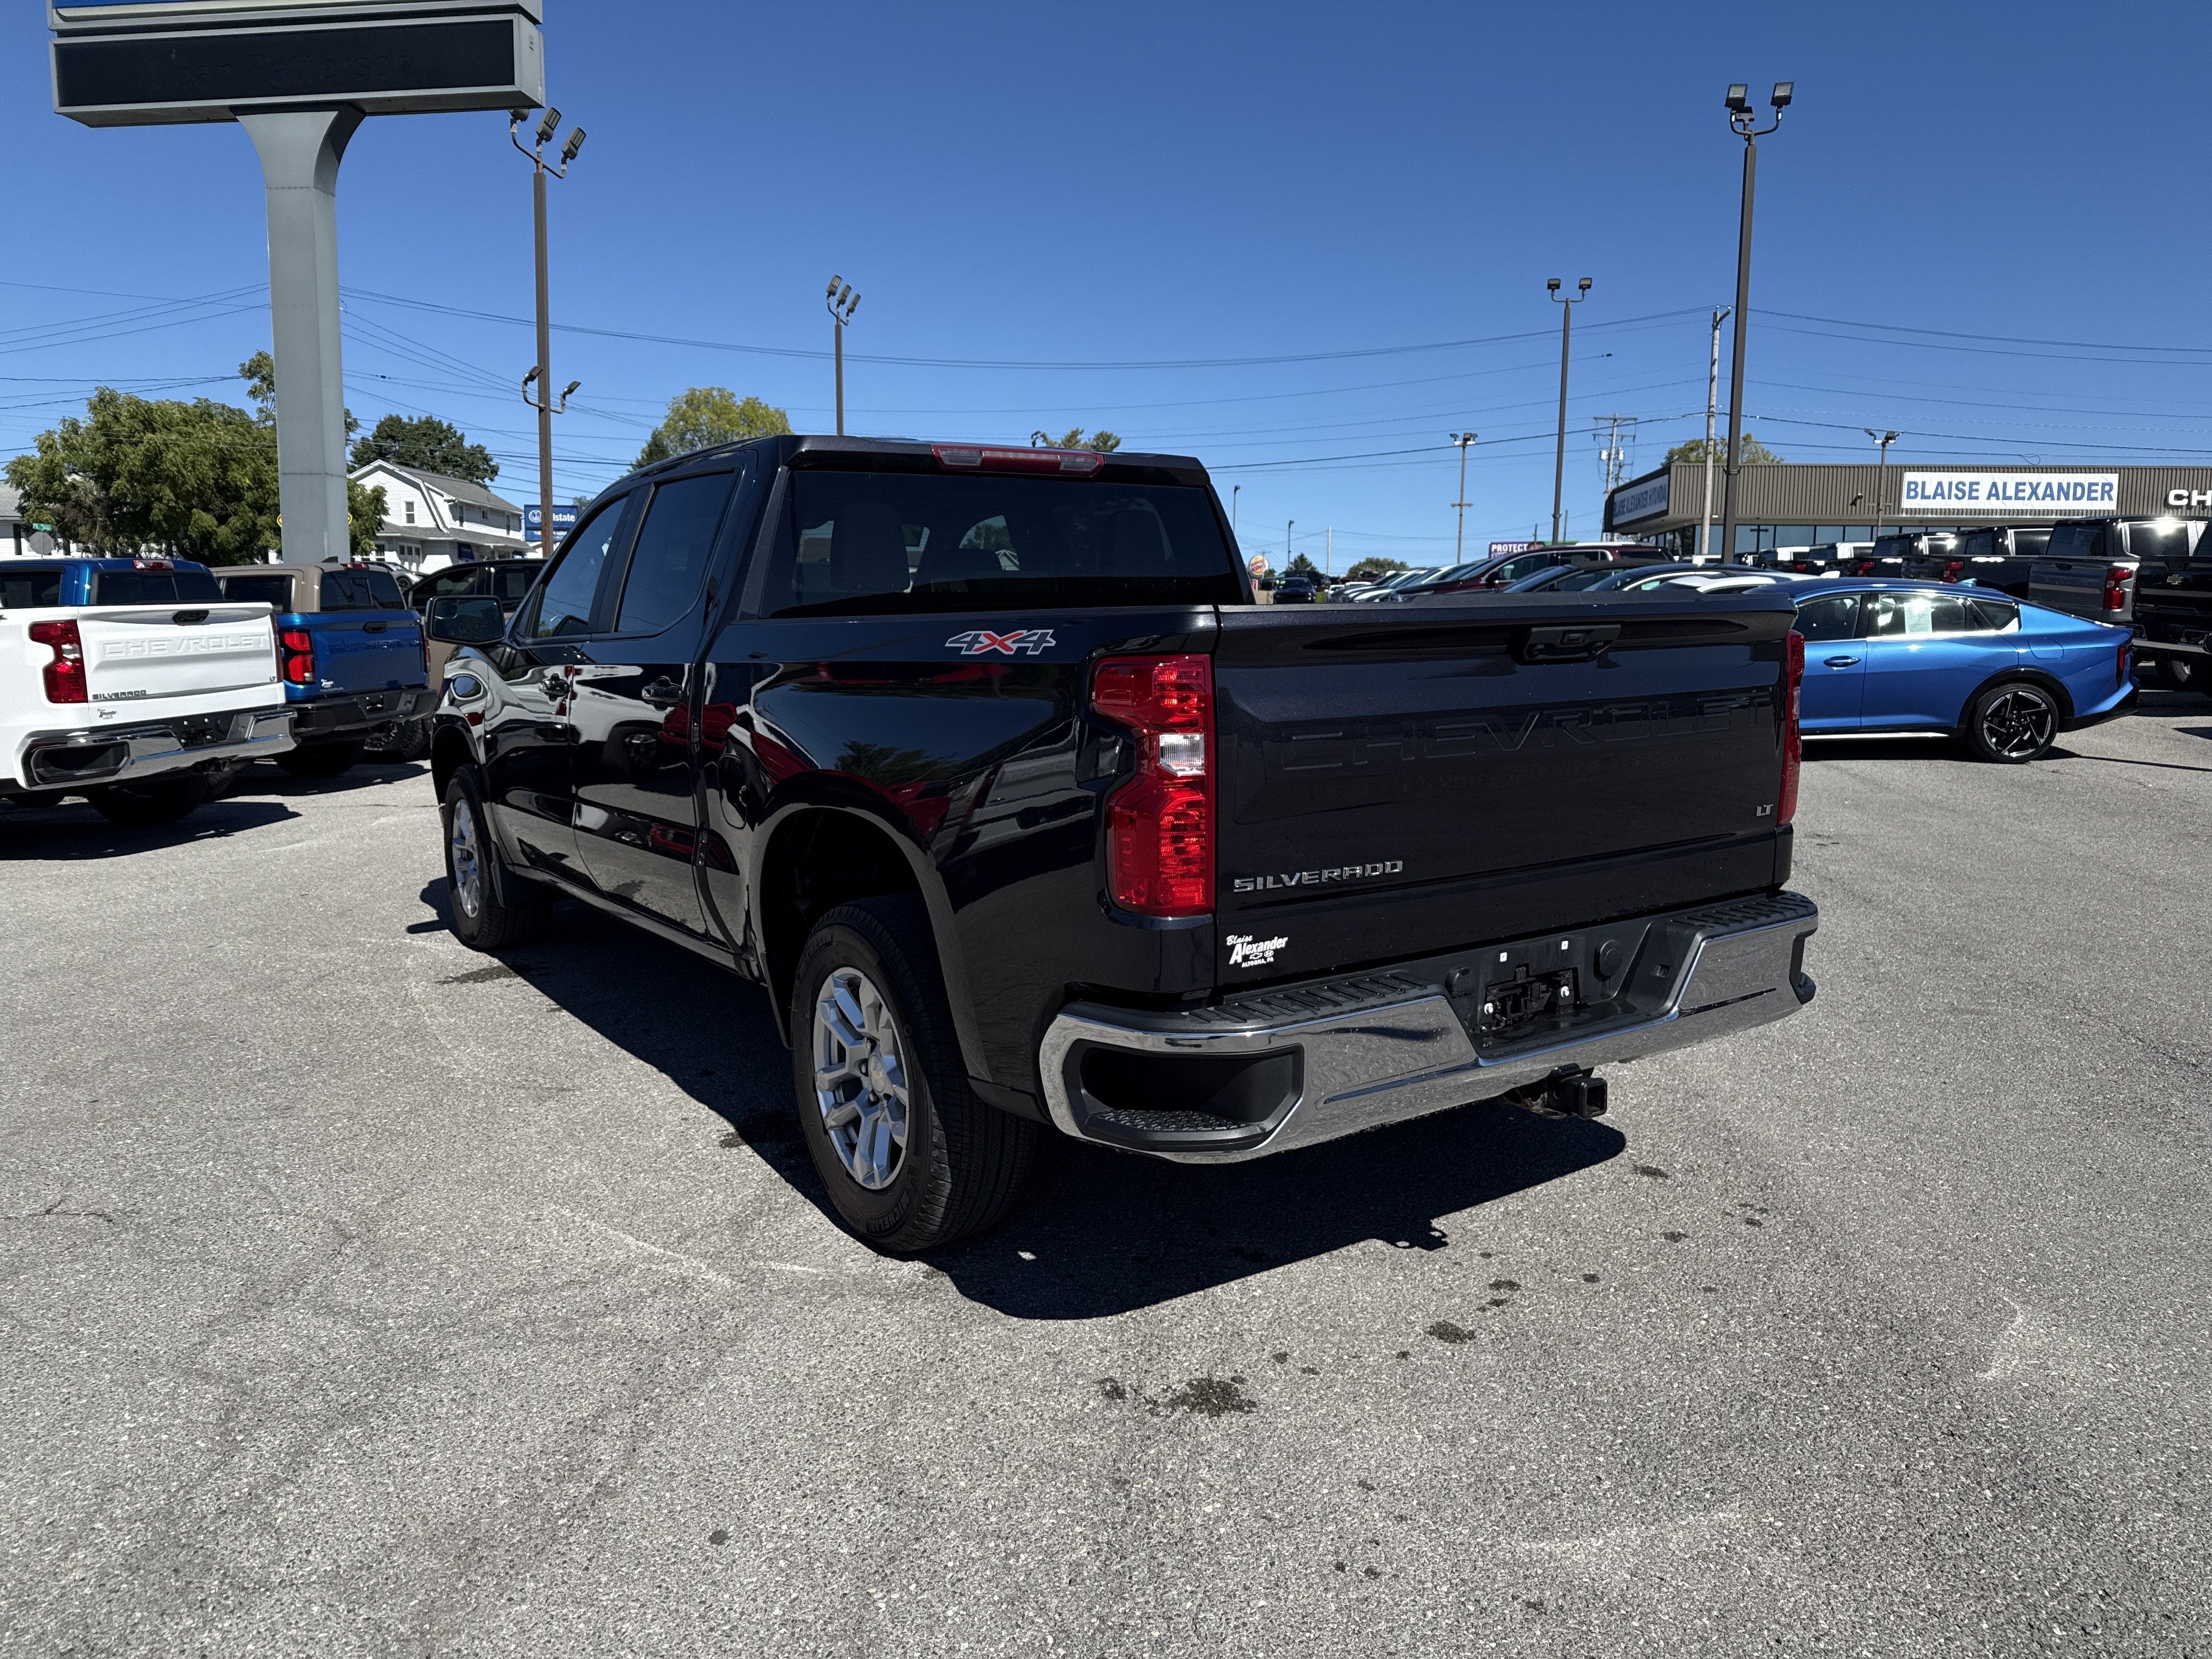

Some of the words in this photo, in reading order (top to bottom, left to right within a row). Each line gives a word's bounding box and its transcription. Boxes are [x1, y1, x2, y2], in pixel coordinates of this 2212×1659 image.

[1906, 481, 1979, 500] BLAISE
[1987, 482, 2114, 501] ALEXANDER
[1492, 543, 1528, 553] PROTECT
[103, 634, 267, 658] CHEVROLET
[92, 689, 147, 701] SILVERADO
[1281, 686, 1771, 771] CHEVROLET
[1756, 804, 1774, 816] LT
[1233, 860, 1403, 893] SILVERADO
[1226, 934, 1253, 946] Blaise
[1229, 936, 1288, 964] Alexander
[868, 1189, 910, 1232] MICHELIN
